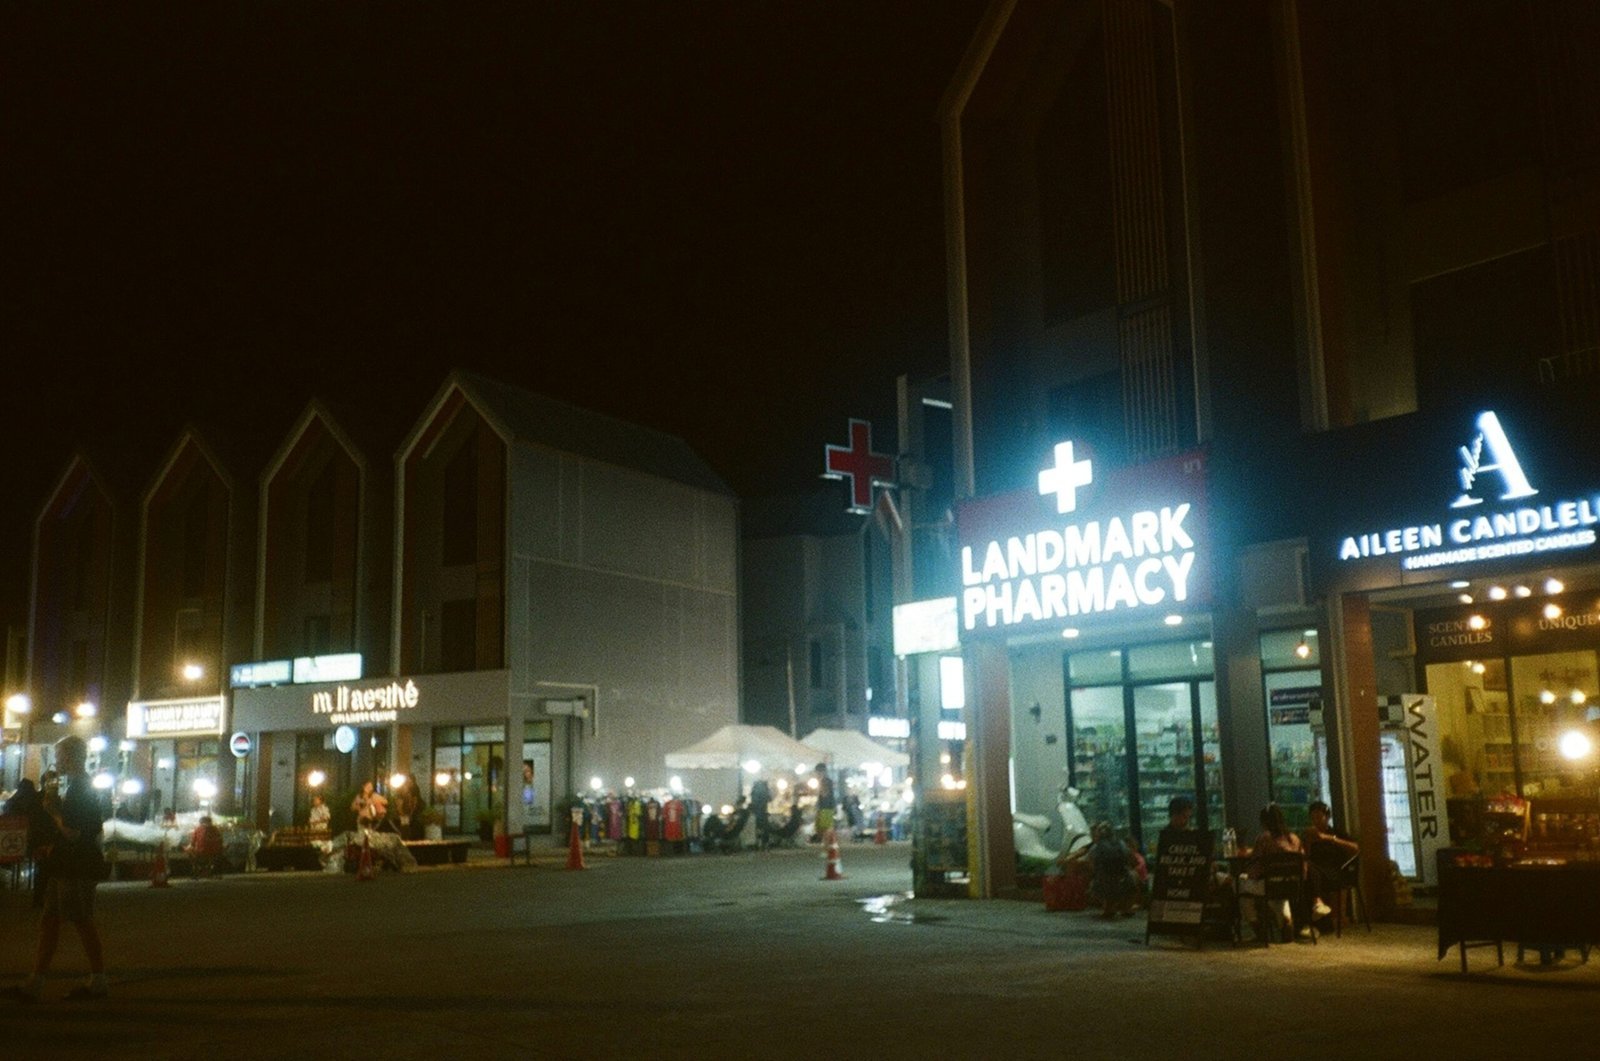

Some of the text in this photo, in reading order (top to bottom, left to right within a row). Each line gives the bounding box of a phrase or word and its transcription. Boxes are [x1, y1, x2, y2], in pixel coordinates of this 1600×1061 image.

[961, 502, 1194, 586] LANDMARK
[1339, 495, 1600, 560] AILEEN CANDLEL
[1403, 529, 1596, 570] HANDMADE SCENTED CANDLES
[963, 551, 1196, 630] PHARMACY
[1430, 631, 1493, 648] CANDLES
[1408, 698, 1437, 840] WATER
